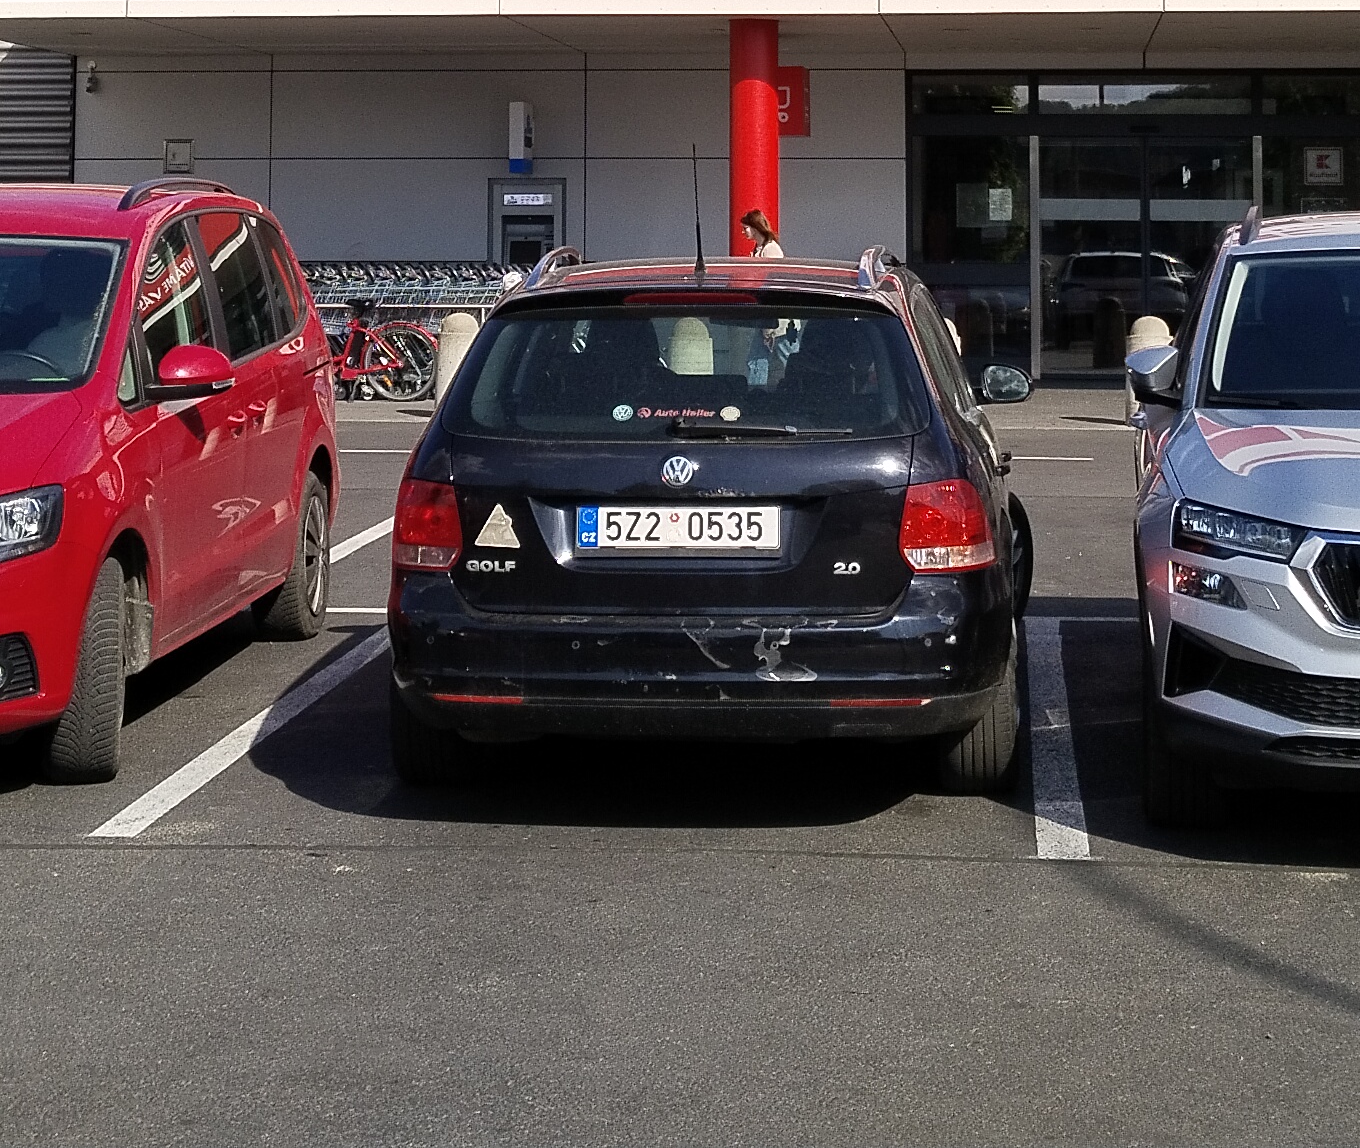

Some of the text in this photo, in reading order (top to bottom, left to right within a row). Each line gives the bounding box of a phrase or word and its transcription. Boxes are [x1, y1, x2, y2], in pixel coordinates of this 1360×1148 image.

[605, 511, 763, 542] 5Z2 0535
[581, 531, 597, 543] CZ
[466, 560, 516, 573] GOLF
